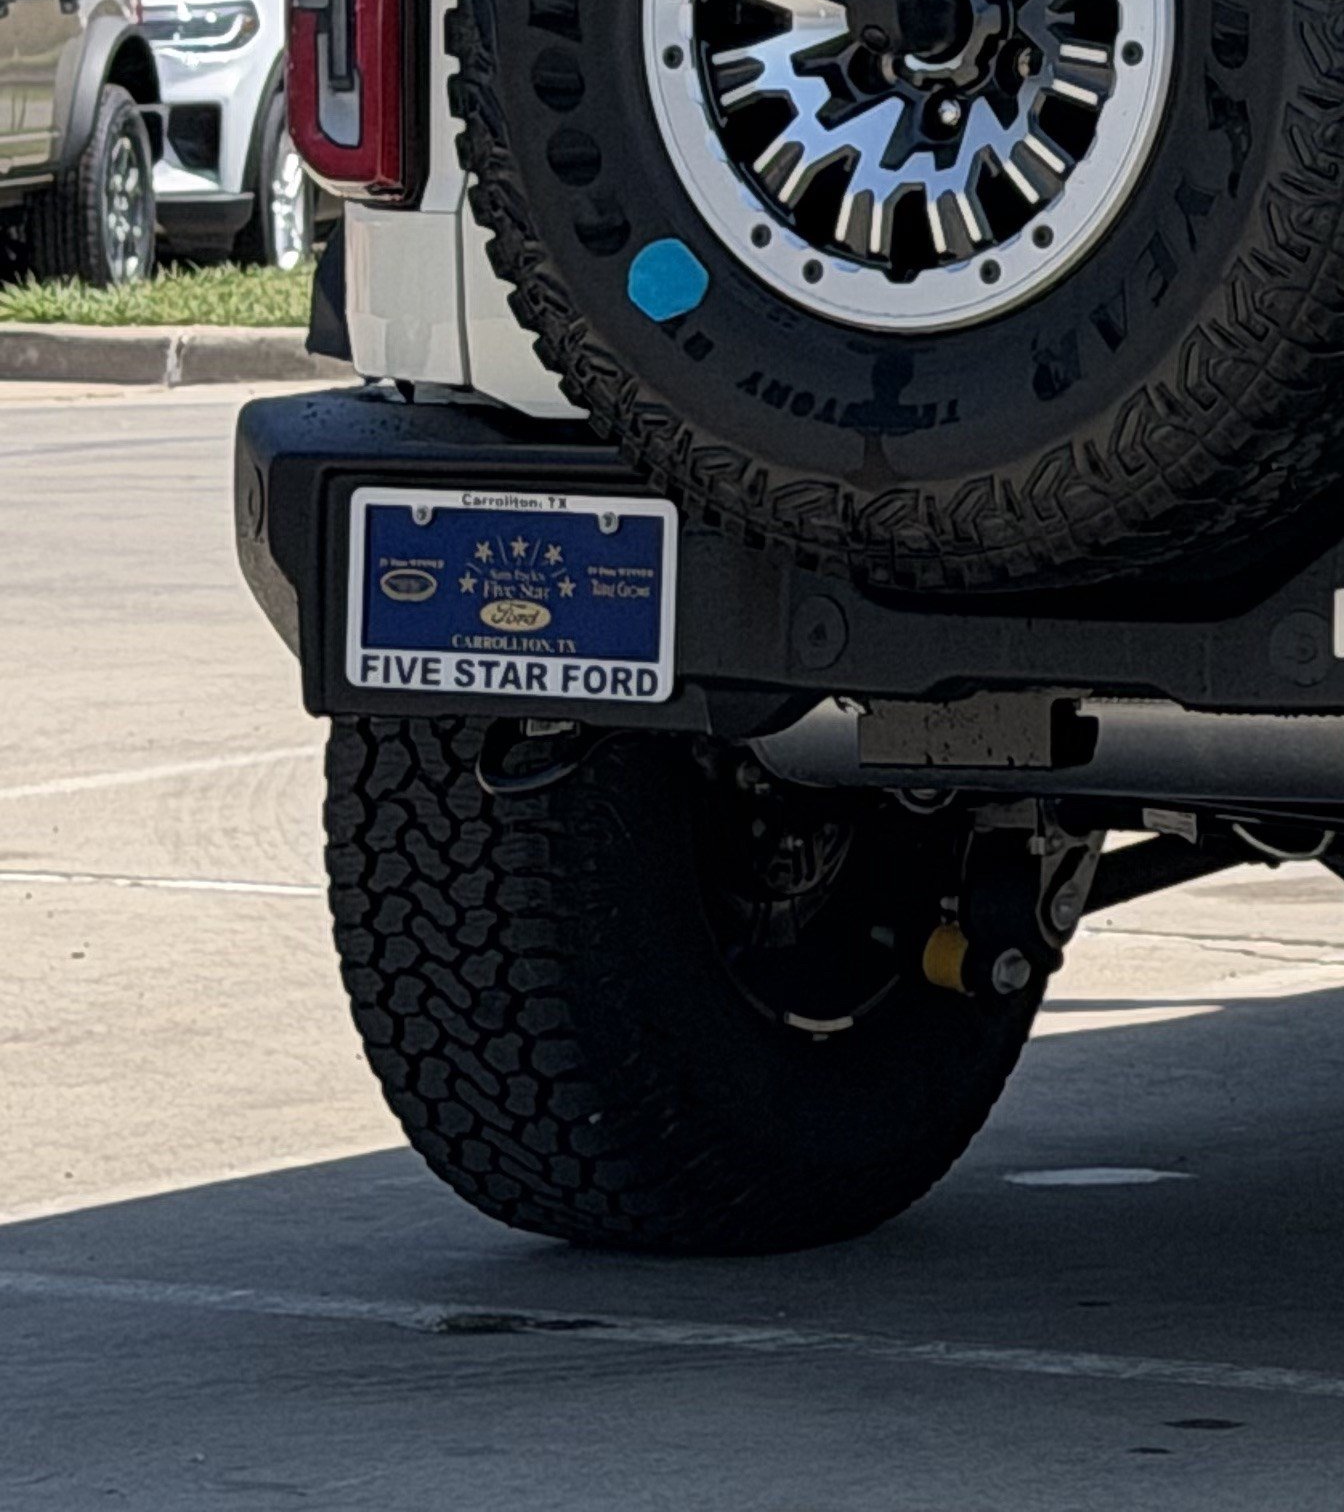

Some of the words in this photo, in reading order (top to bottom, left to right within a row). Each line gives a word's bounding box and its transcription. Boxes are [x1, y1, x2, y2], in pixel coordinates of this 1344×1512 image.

[737, 370, 961, 430] TETORY
[359, 653, 442, 686] FIVE
[453, 658, 548, 691] STAR
[560, 663, 659, 697] FORD
